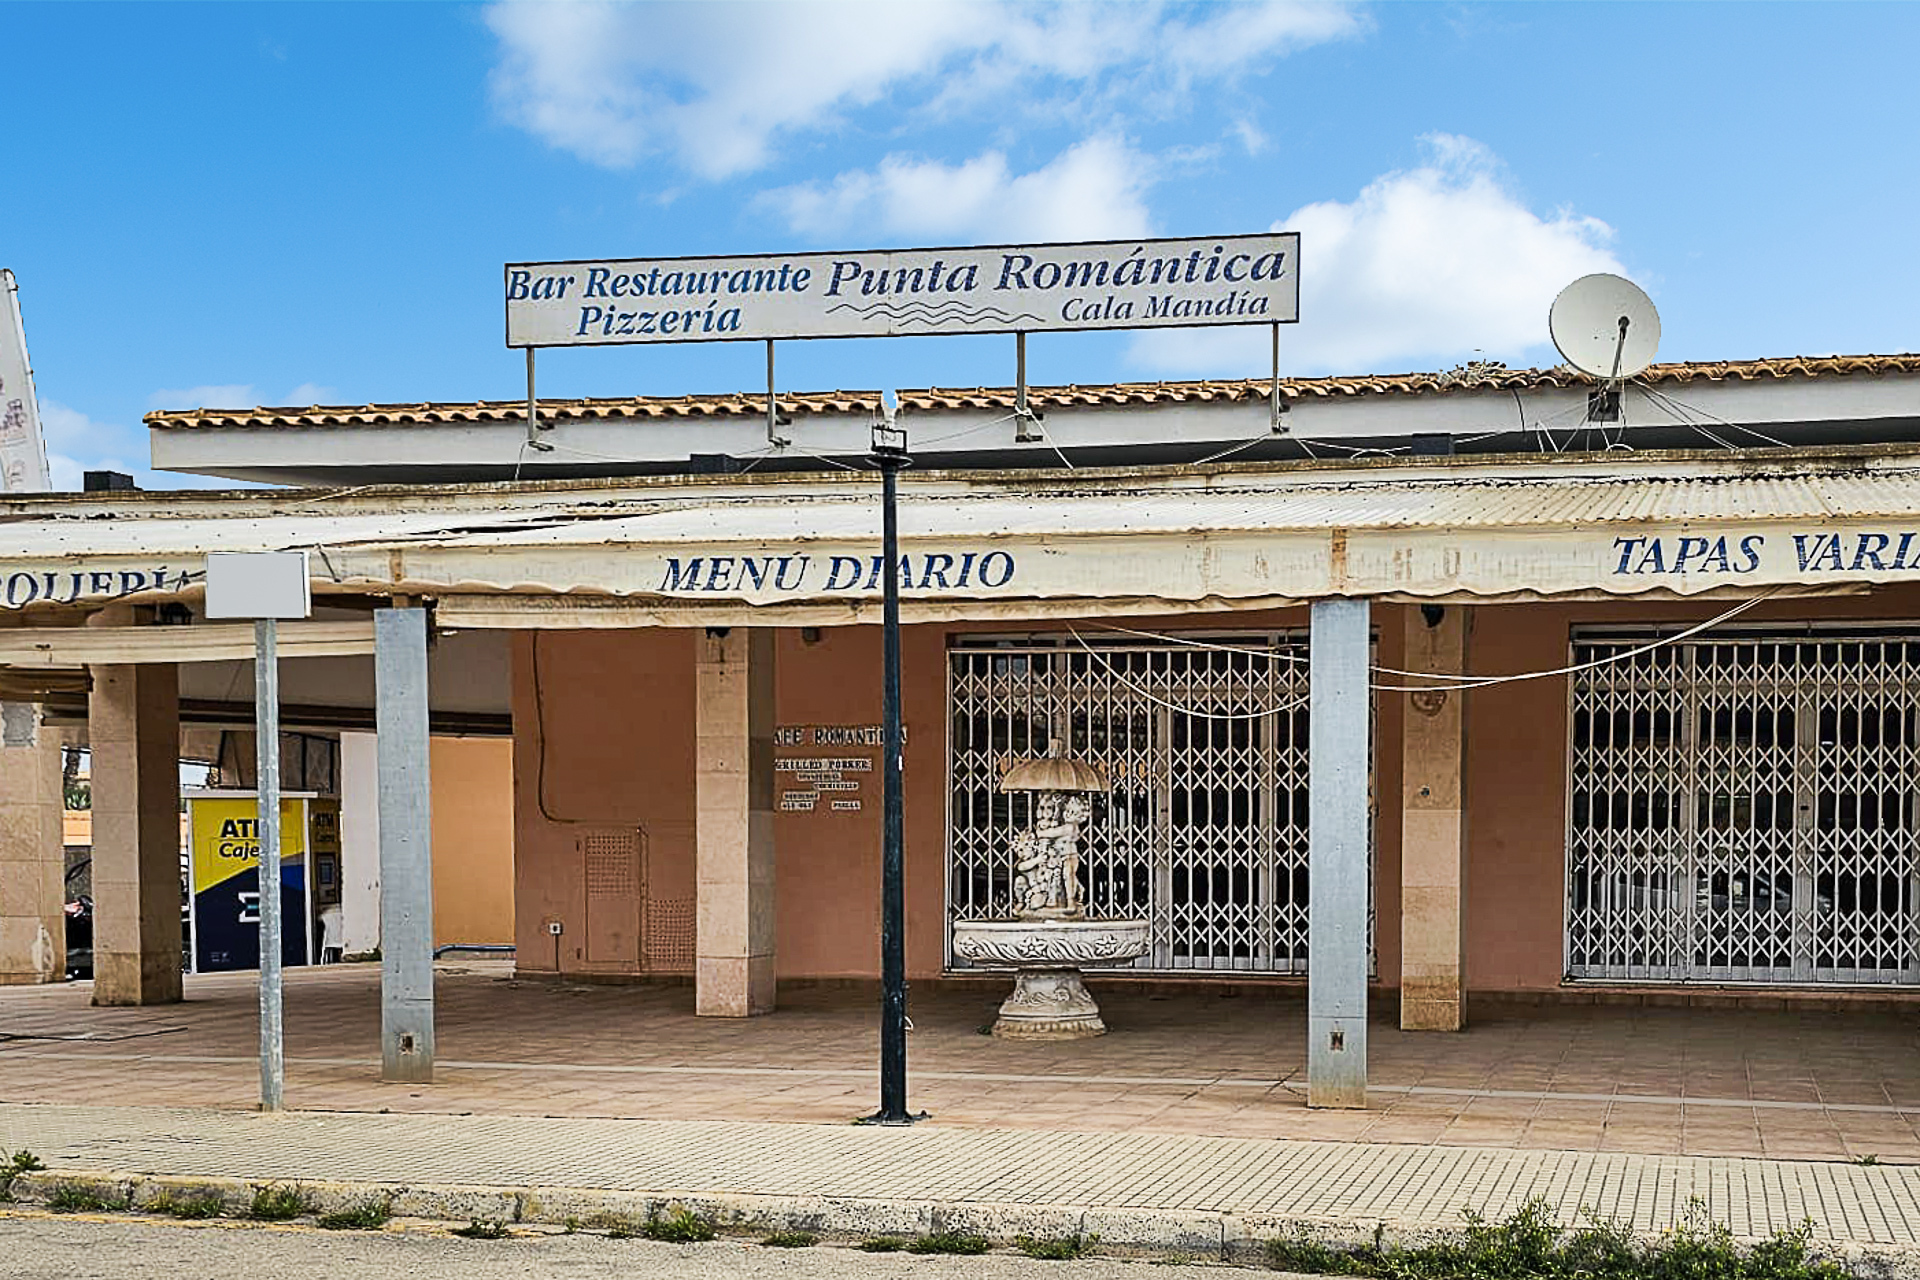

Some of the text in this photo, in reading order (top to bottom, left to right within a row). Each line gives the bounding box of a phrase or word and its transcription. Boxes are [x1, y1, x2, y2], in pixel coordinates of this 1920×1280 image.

[507, 245, 1286, 301] Bar Restaurante Punta Romántica
[576, 299, 742, 336] Pizzería
[1061, 290, 1270, 323] Cala Mandía
[657, 551, 1015, 592] MENÚ DIARIO
[1612, 535, 1765, 574] TAPAS
[774, 726, 907, 745] AFE ROMANTI
[220, 819, 258, 838] AT
[219, 842, 259, 861] Caje
